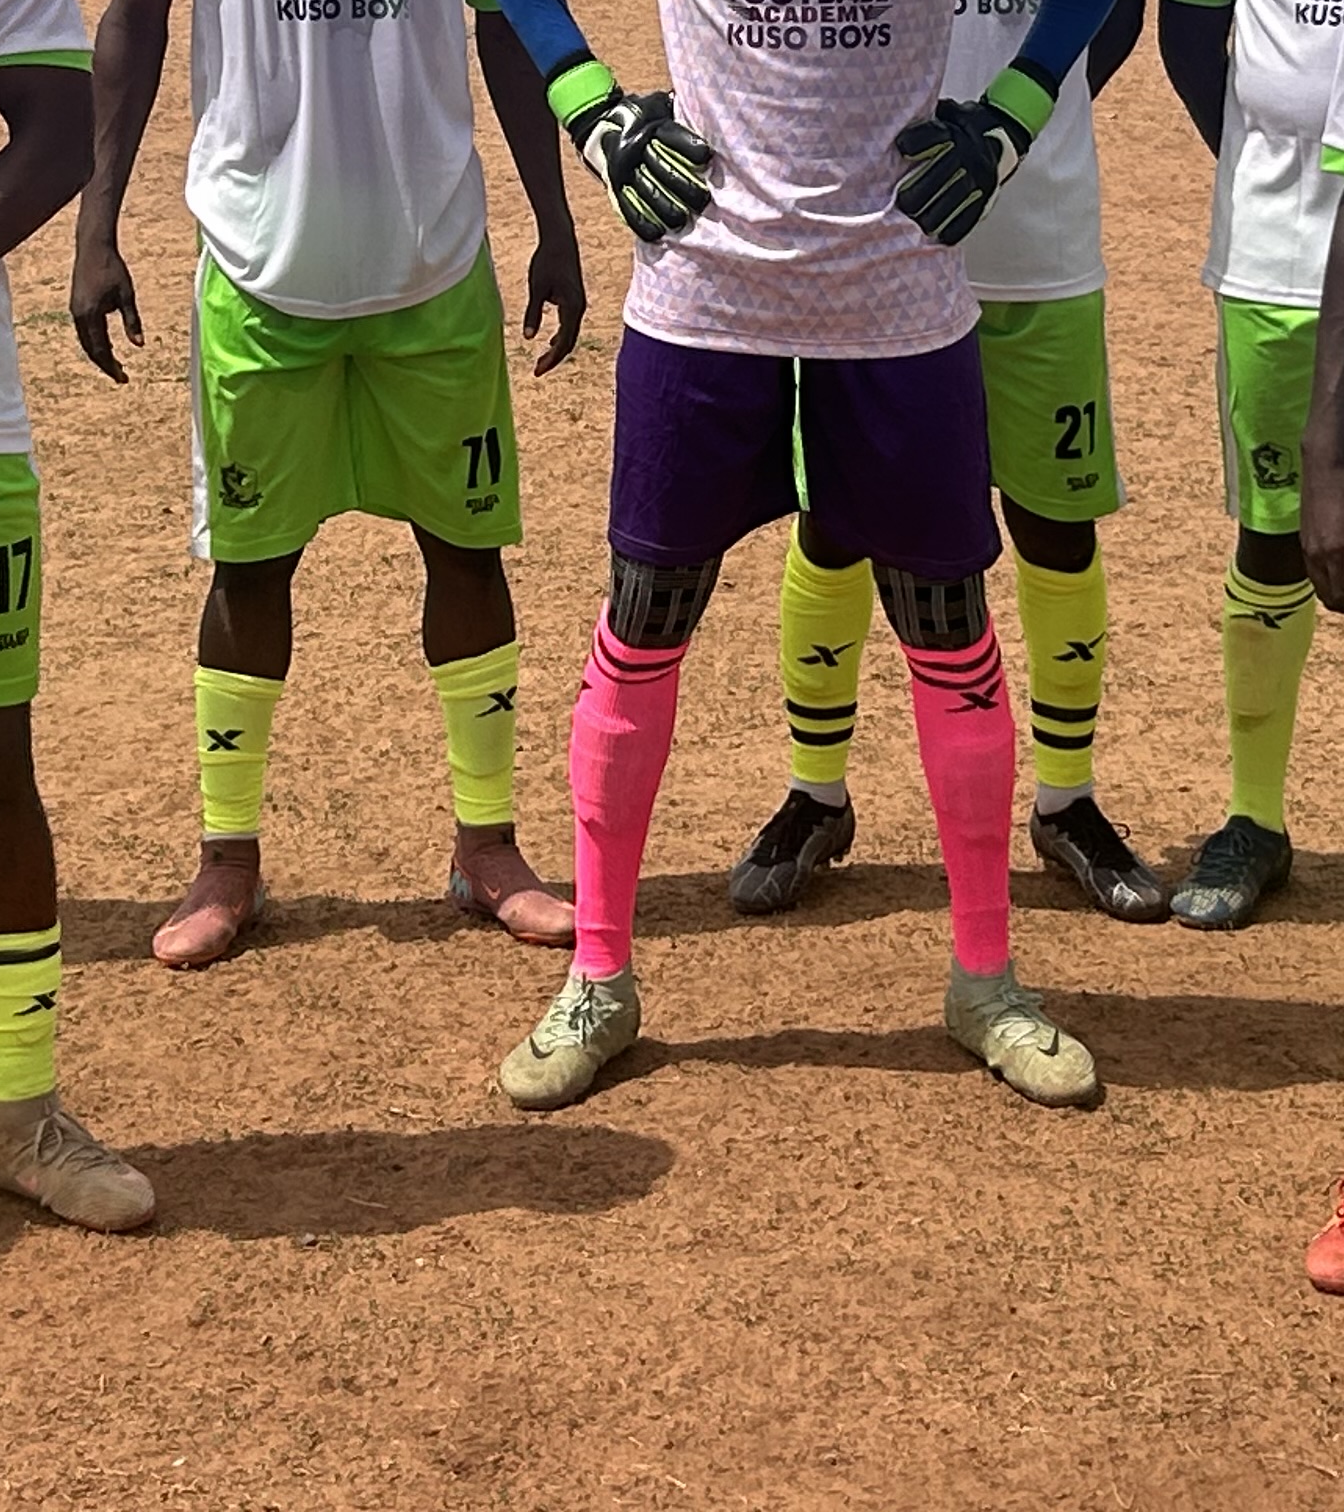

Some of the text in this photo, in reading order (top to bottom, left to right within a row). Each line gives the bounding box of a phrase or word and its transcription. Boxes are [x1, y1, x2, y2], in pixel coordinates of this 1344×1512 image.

[748, 5, 873, 23] ACADEMY
[728, 24, 891, 50] KUSO BOYS
[1055, 401, 1095, 459] 21
